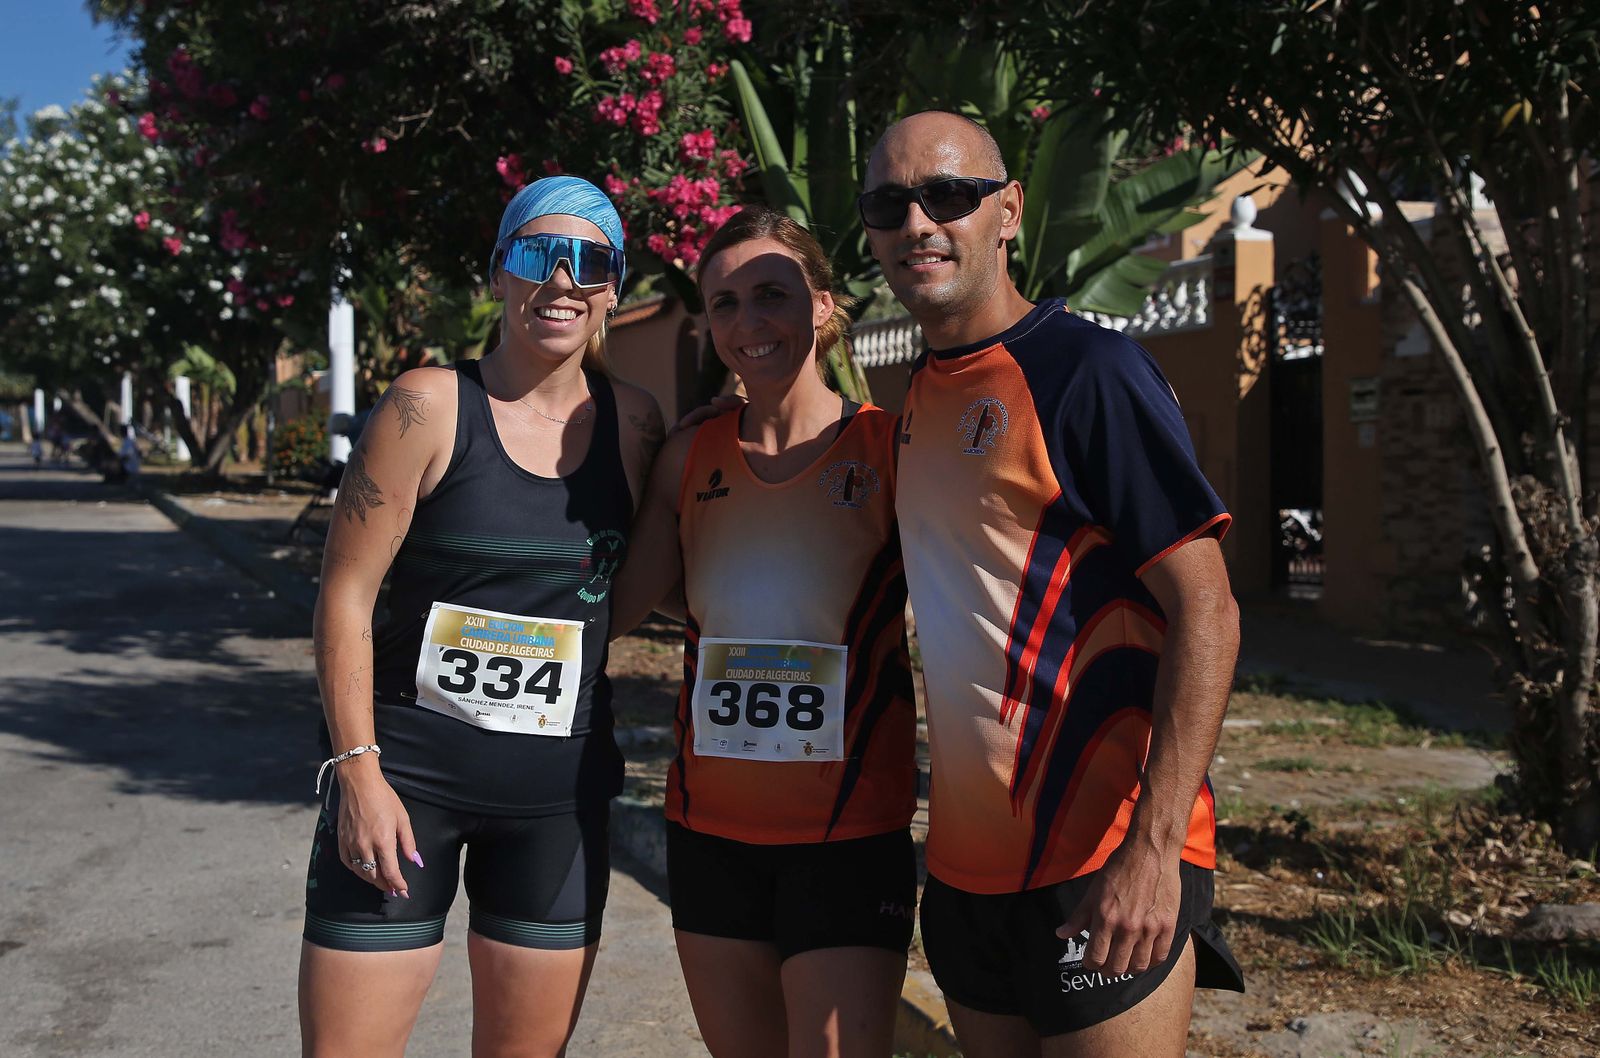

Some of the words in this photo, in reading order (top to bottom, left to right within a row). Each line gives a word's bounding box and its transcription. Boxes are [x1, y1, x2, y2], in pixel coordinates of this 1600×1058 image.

[464, 615, 486, 628] XXIII
[461, 625, 510, 643] CARRERA
[512, 634, 555, 648] URBANA
[460, 637, 496, 653] CIUDAD
[496, 643, 509, 655] DE
[509, 644, 555, 658] ALGECIRAS
[729, 647, 746, 656] XXIII
[437, 648, 563, 704] 334
[726, 669, 755, 679] CIUDAD
[755, 669, 766, 680] DE
[766, 670, 811, 682] ALGECIRAS
[708, 681, 825, 731] 368
